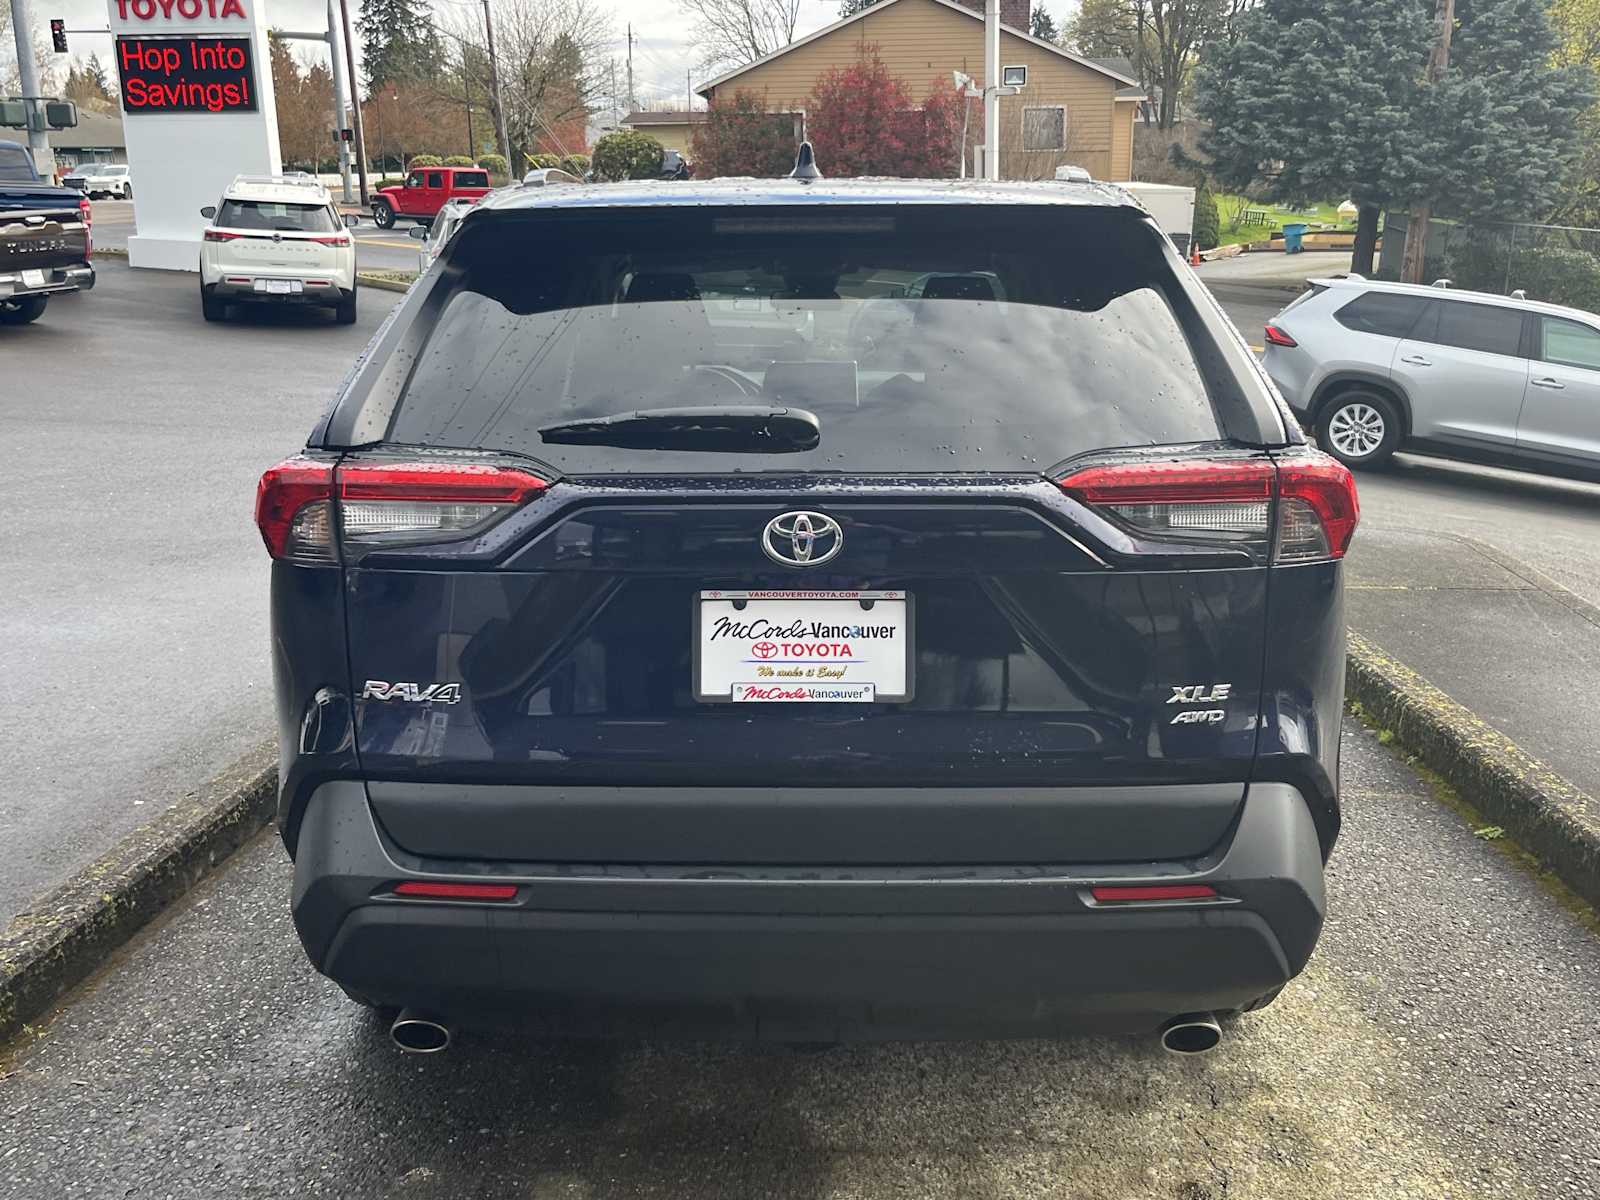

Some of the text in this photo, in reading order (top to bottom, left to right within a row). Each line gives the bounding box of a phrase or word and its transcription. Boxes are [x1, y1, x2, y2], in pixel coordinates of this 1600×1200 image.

[116, 0, 247, 20] TOYOTA
[121, 41, 246, 77] Hop Into
[126, 77, 249, 112] Savings!
[748, 591, 859, 599] VANCOUVERTOYOTA.COM
[782, 643, 852, 657] TOYOTA
[757, 665, 774, 677] We
[776, 666, 803, 677] make
[816, 665, 848, 680] Easy!
[362, 680, 462, 704] RAV4
[1166, 683, 1232, 703] XLE
[1170, 709, 1225, 724] AWD
